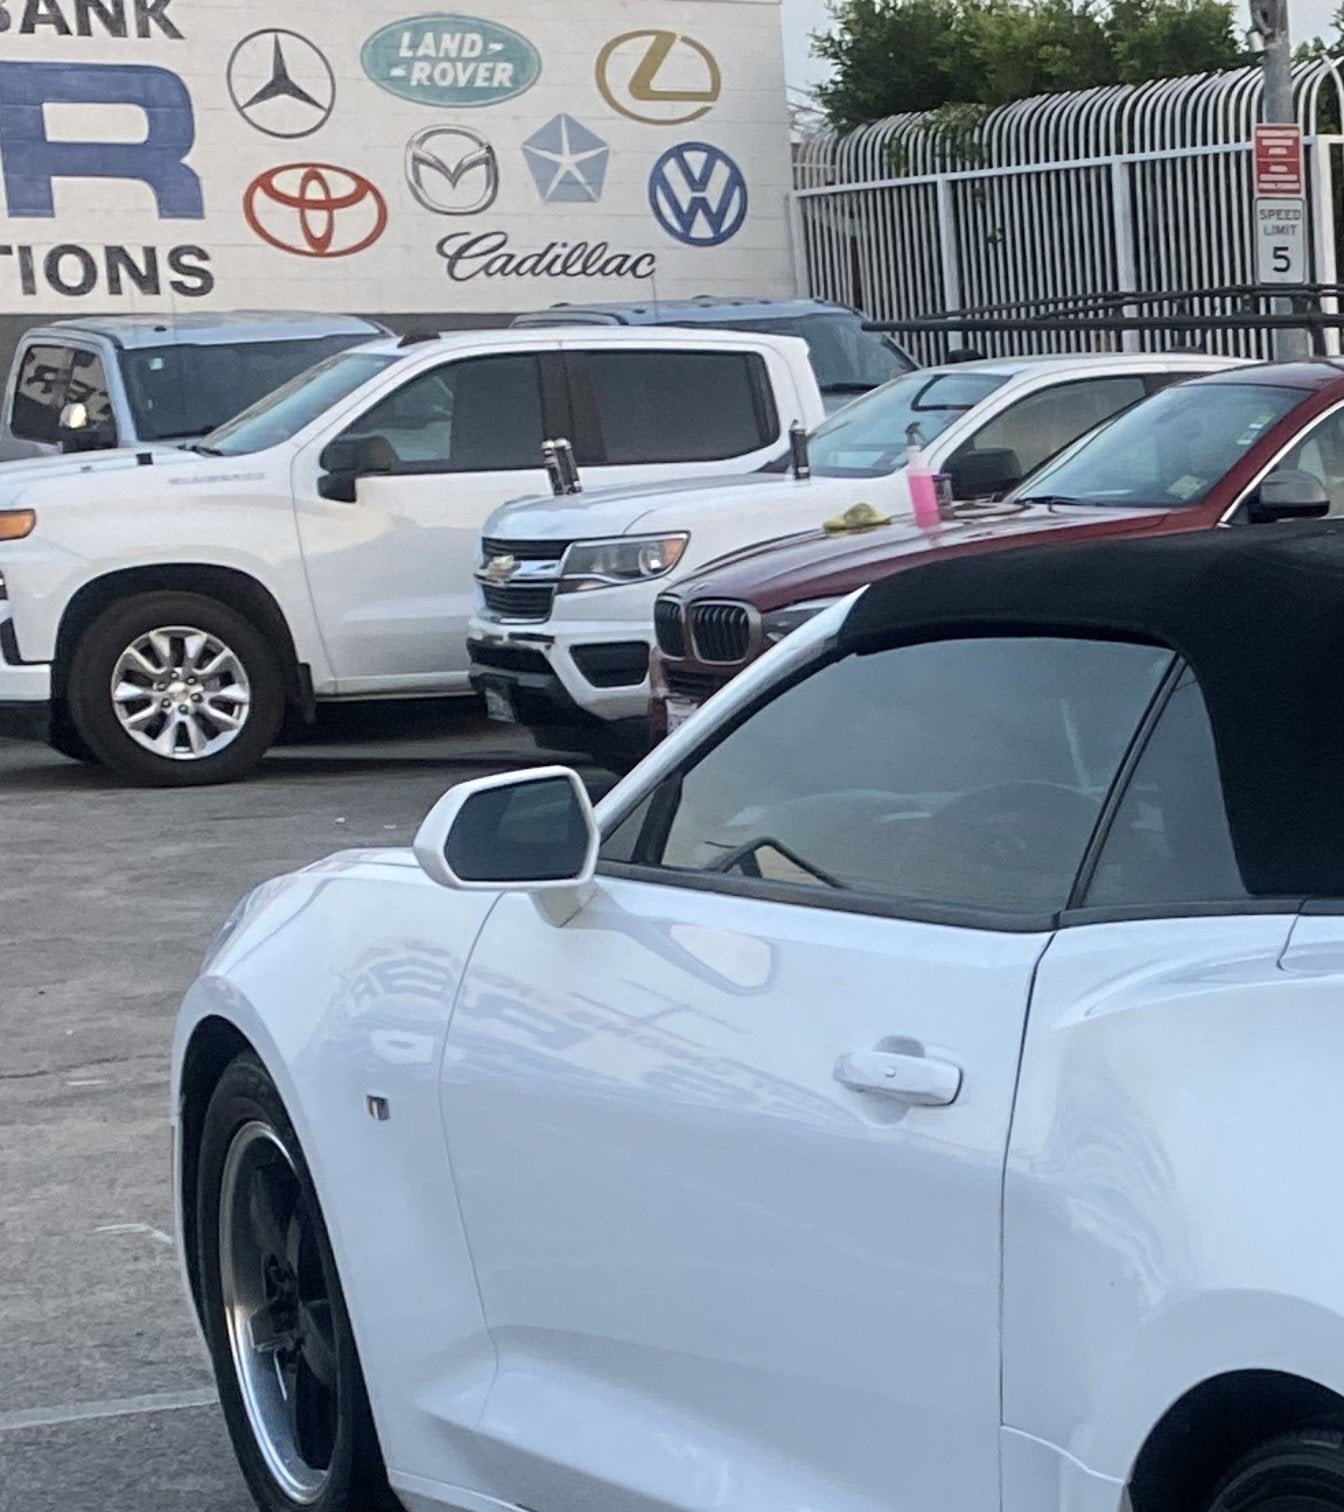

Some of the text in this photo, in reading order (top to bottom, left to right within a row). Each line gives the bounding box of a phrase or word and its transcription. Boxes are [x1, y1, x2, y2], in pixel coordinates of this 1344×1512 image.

[0, 0, 186, 39] ANK
[1259, 208, 1301, 221] SPEED
[1263, 224, 1298, 236] LIMIT
[0, 244, 214, 297] IONS
[436, 231, 656, 281] Cadillac
[1272, 246, 1291, 272] 5
